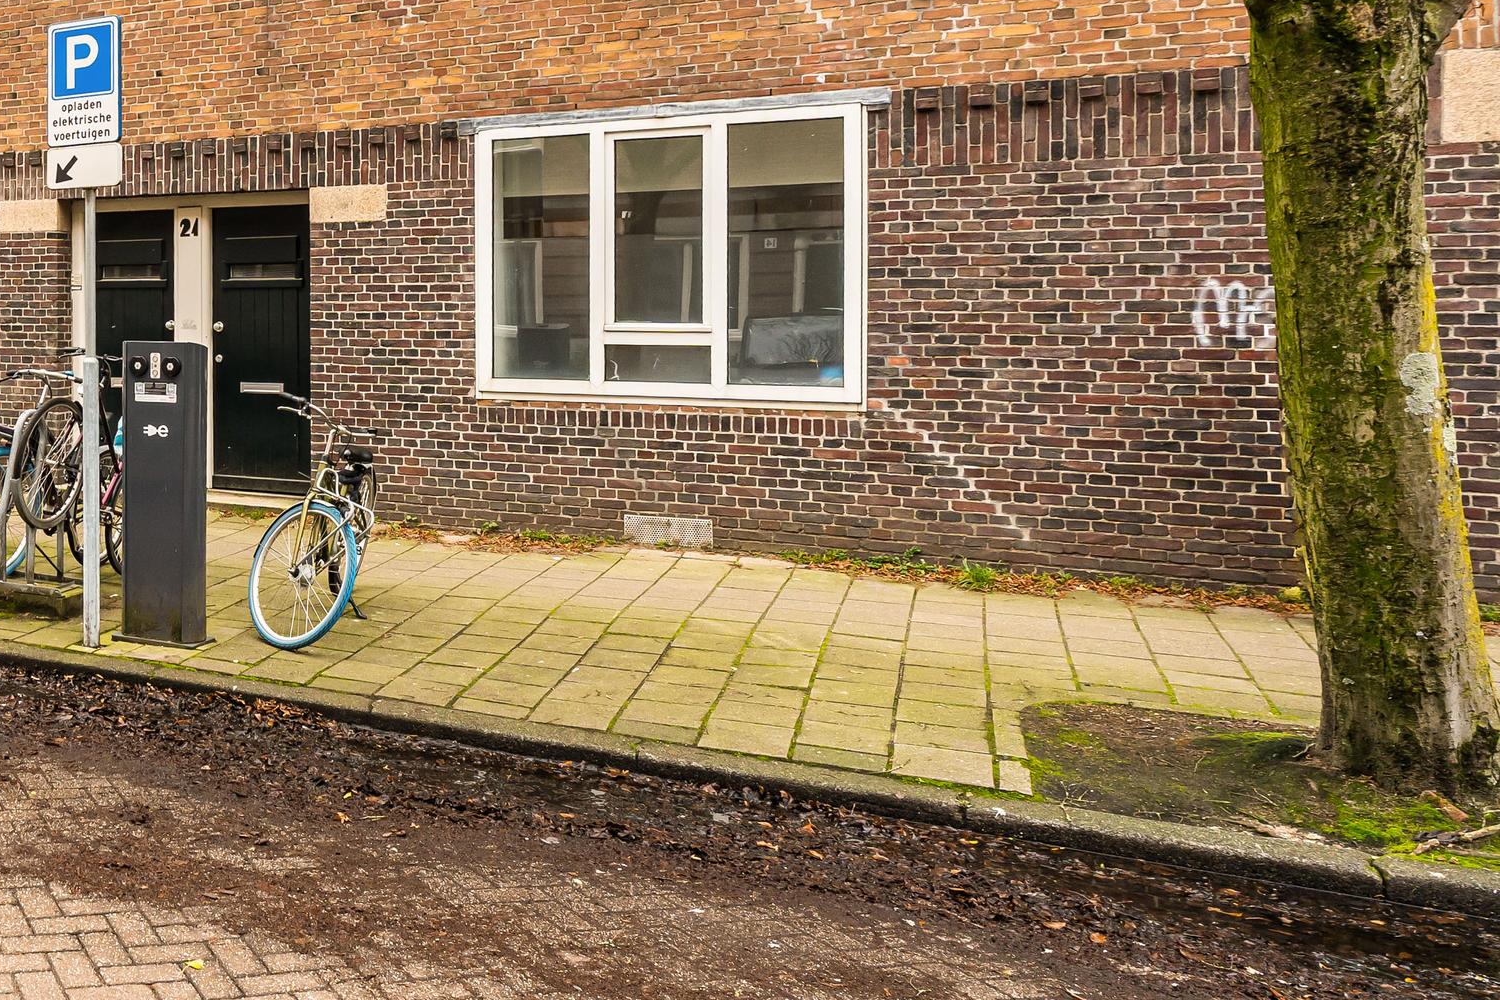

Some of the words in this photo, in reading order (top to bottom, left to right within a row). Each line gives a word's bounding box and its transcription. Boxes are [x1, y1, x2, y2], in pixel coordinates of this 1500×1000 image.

[66, 34, 99, 90] P
[61, 100, 102, 113] opladen
[52, 113, 112, 128] elektrische
[54, 128, 110, 142] voertuigen
